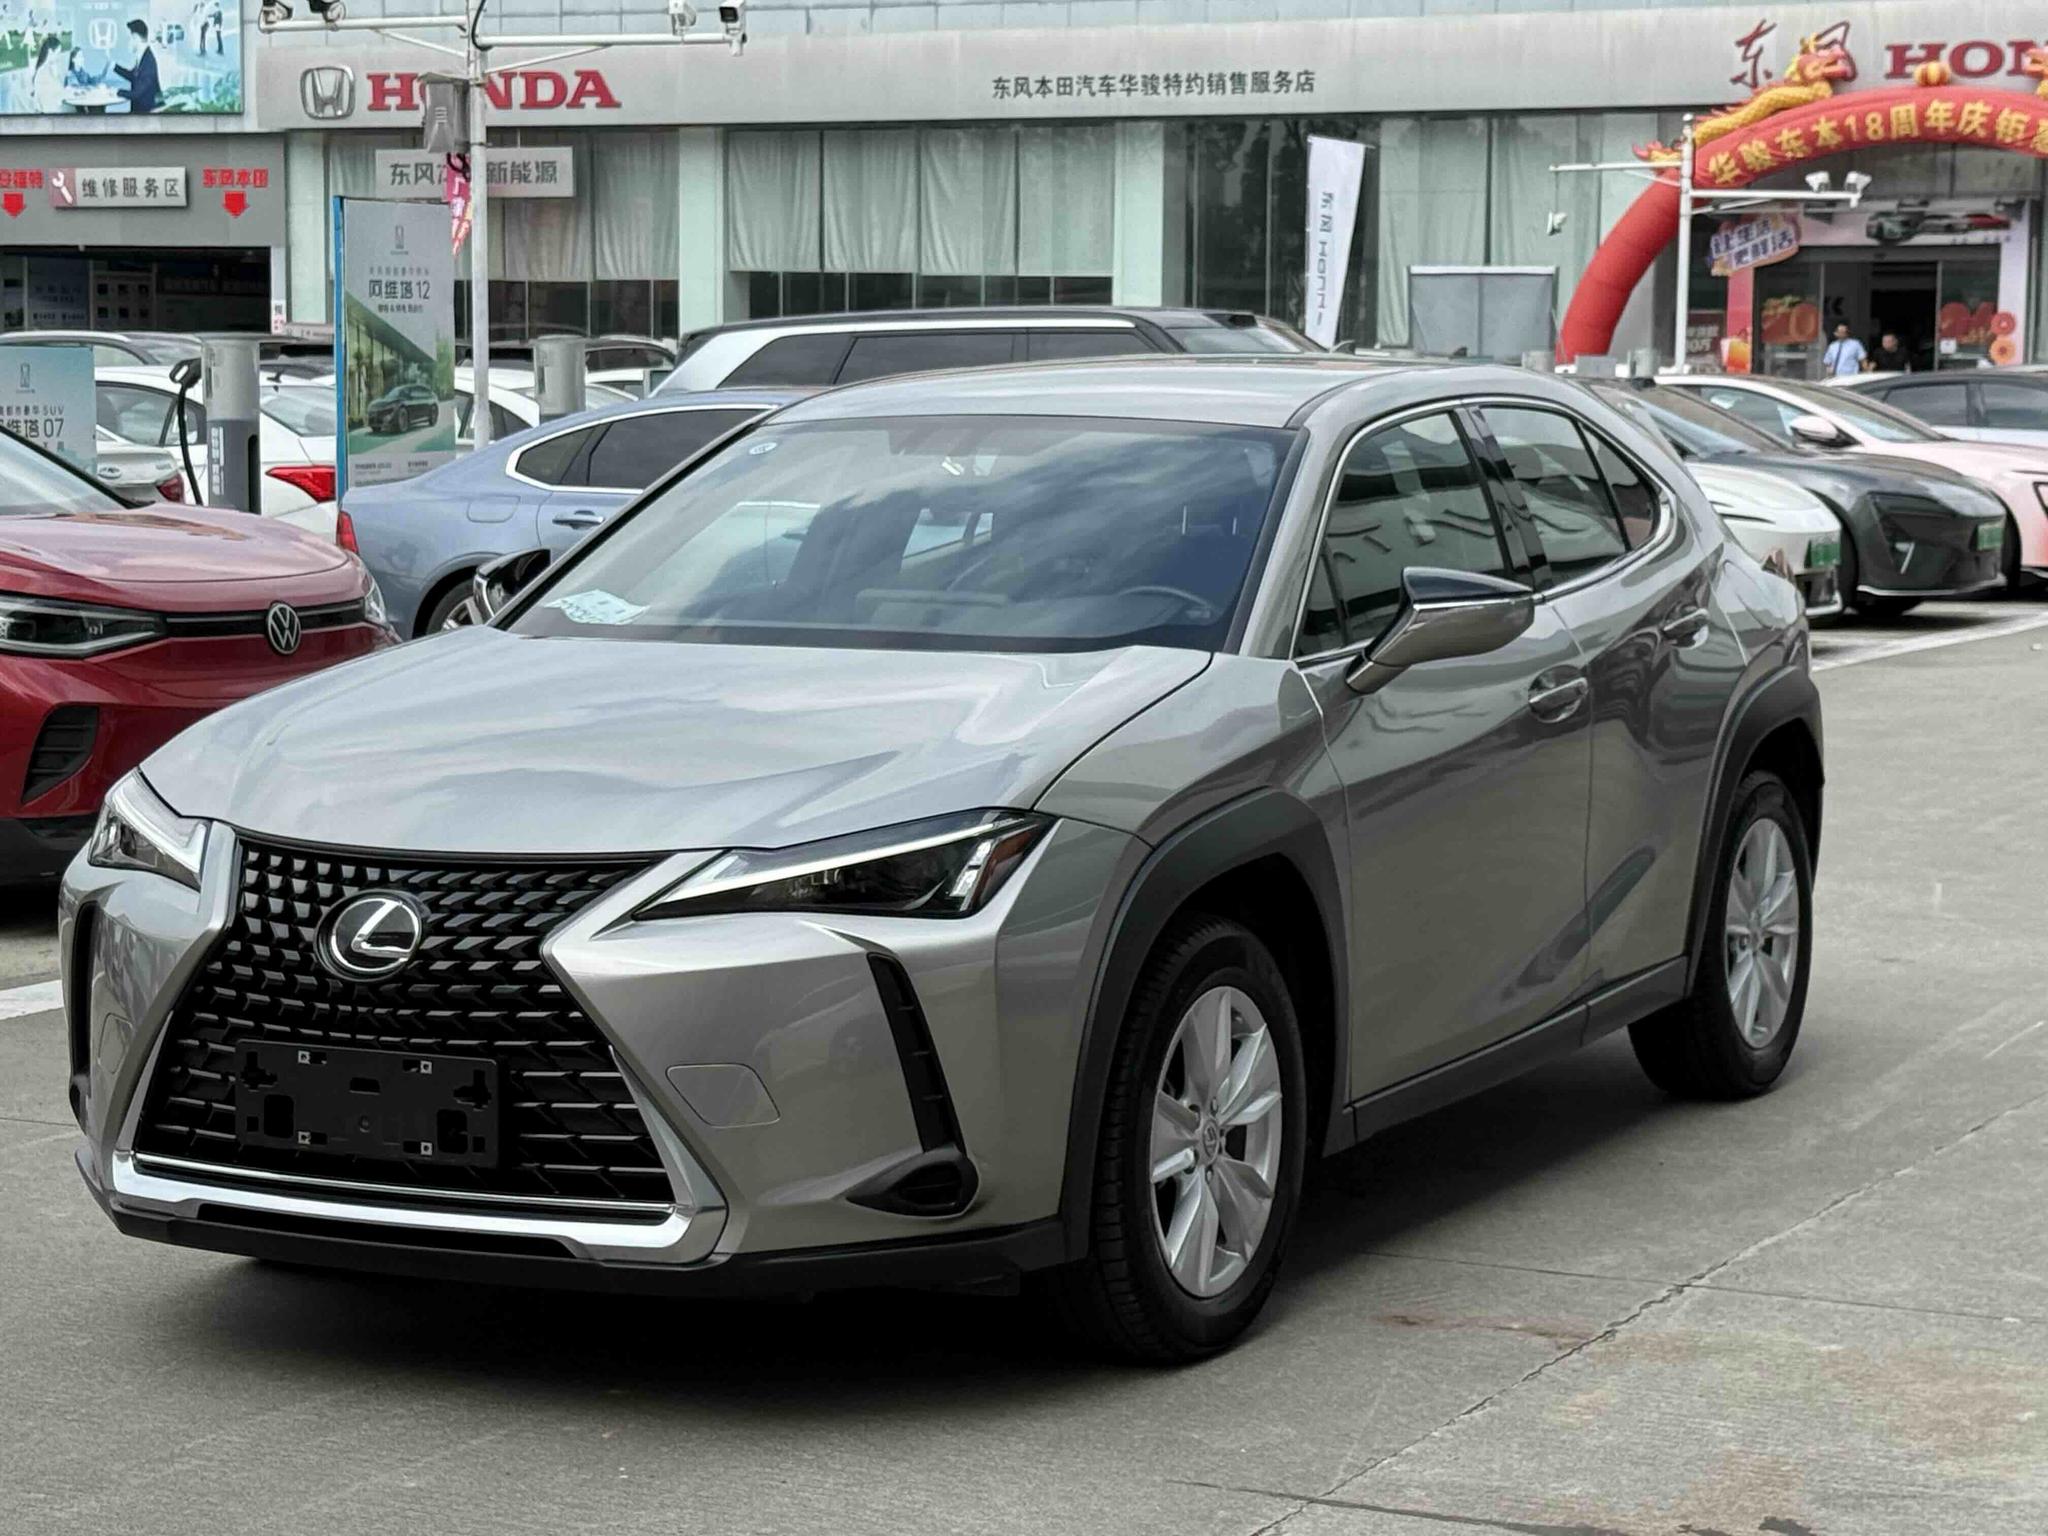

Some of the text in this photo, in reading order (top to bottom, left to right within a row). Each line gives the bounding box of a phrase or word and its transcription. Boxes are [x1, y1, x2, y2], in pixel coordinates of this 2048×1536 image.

[367, 70, 622, 111] HNDA
[992, 69, 1315, 99] 东风本田汽车华骏特约销售服务店
[390, 160, 558, 186] 东风新能源
[82, 177, 180, 199] 维修服务区
[0, 418, 64, 438] 维塔07
